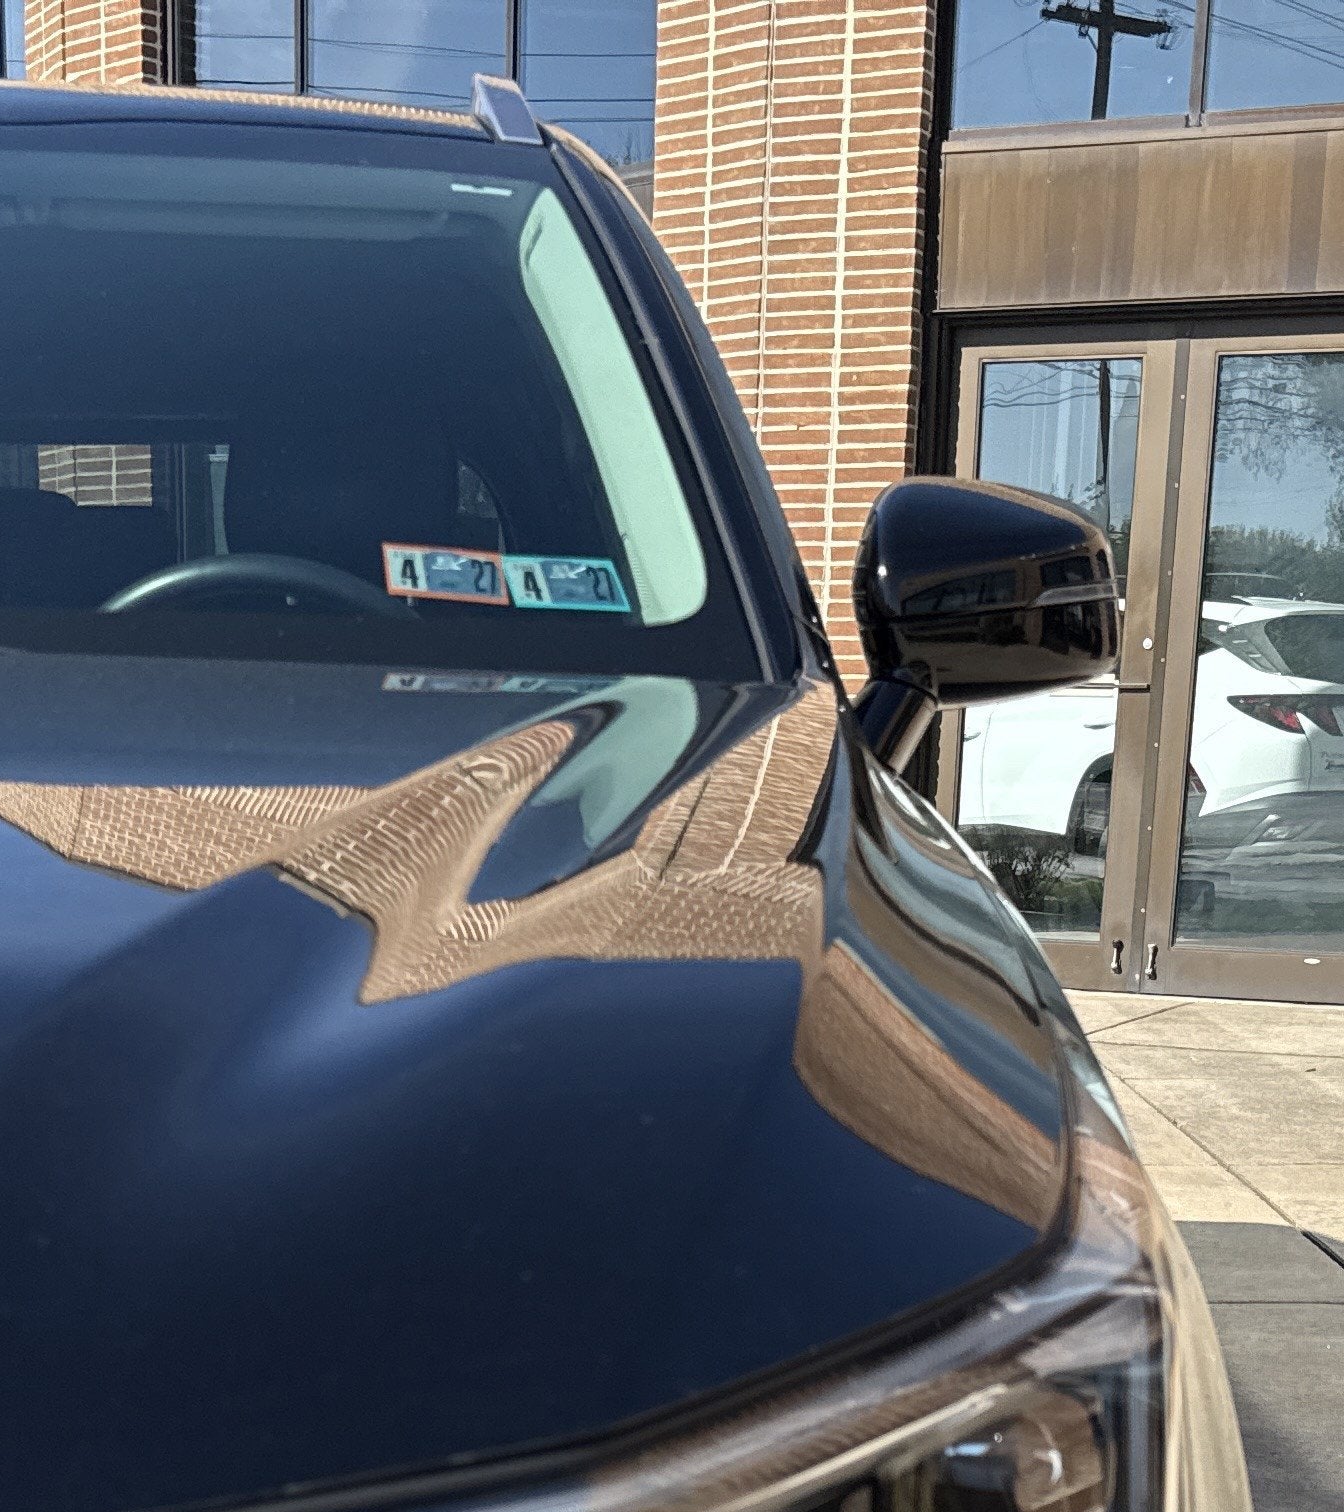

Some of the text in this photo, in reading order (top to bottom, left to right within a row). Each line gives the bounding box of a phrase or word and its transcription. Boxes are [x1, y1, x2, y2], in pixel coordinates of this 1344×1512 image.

[401, 559, 496, 595] 4 27
[523, 571, 543, 602] 4
